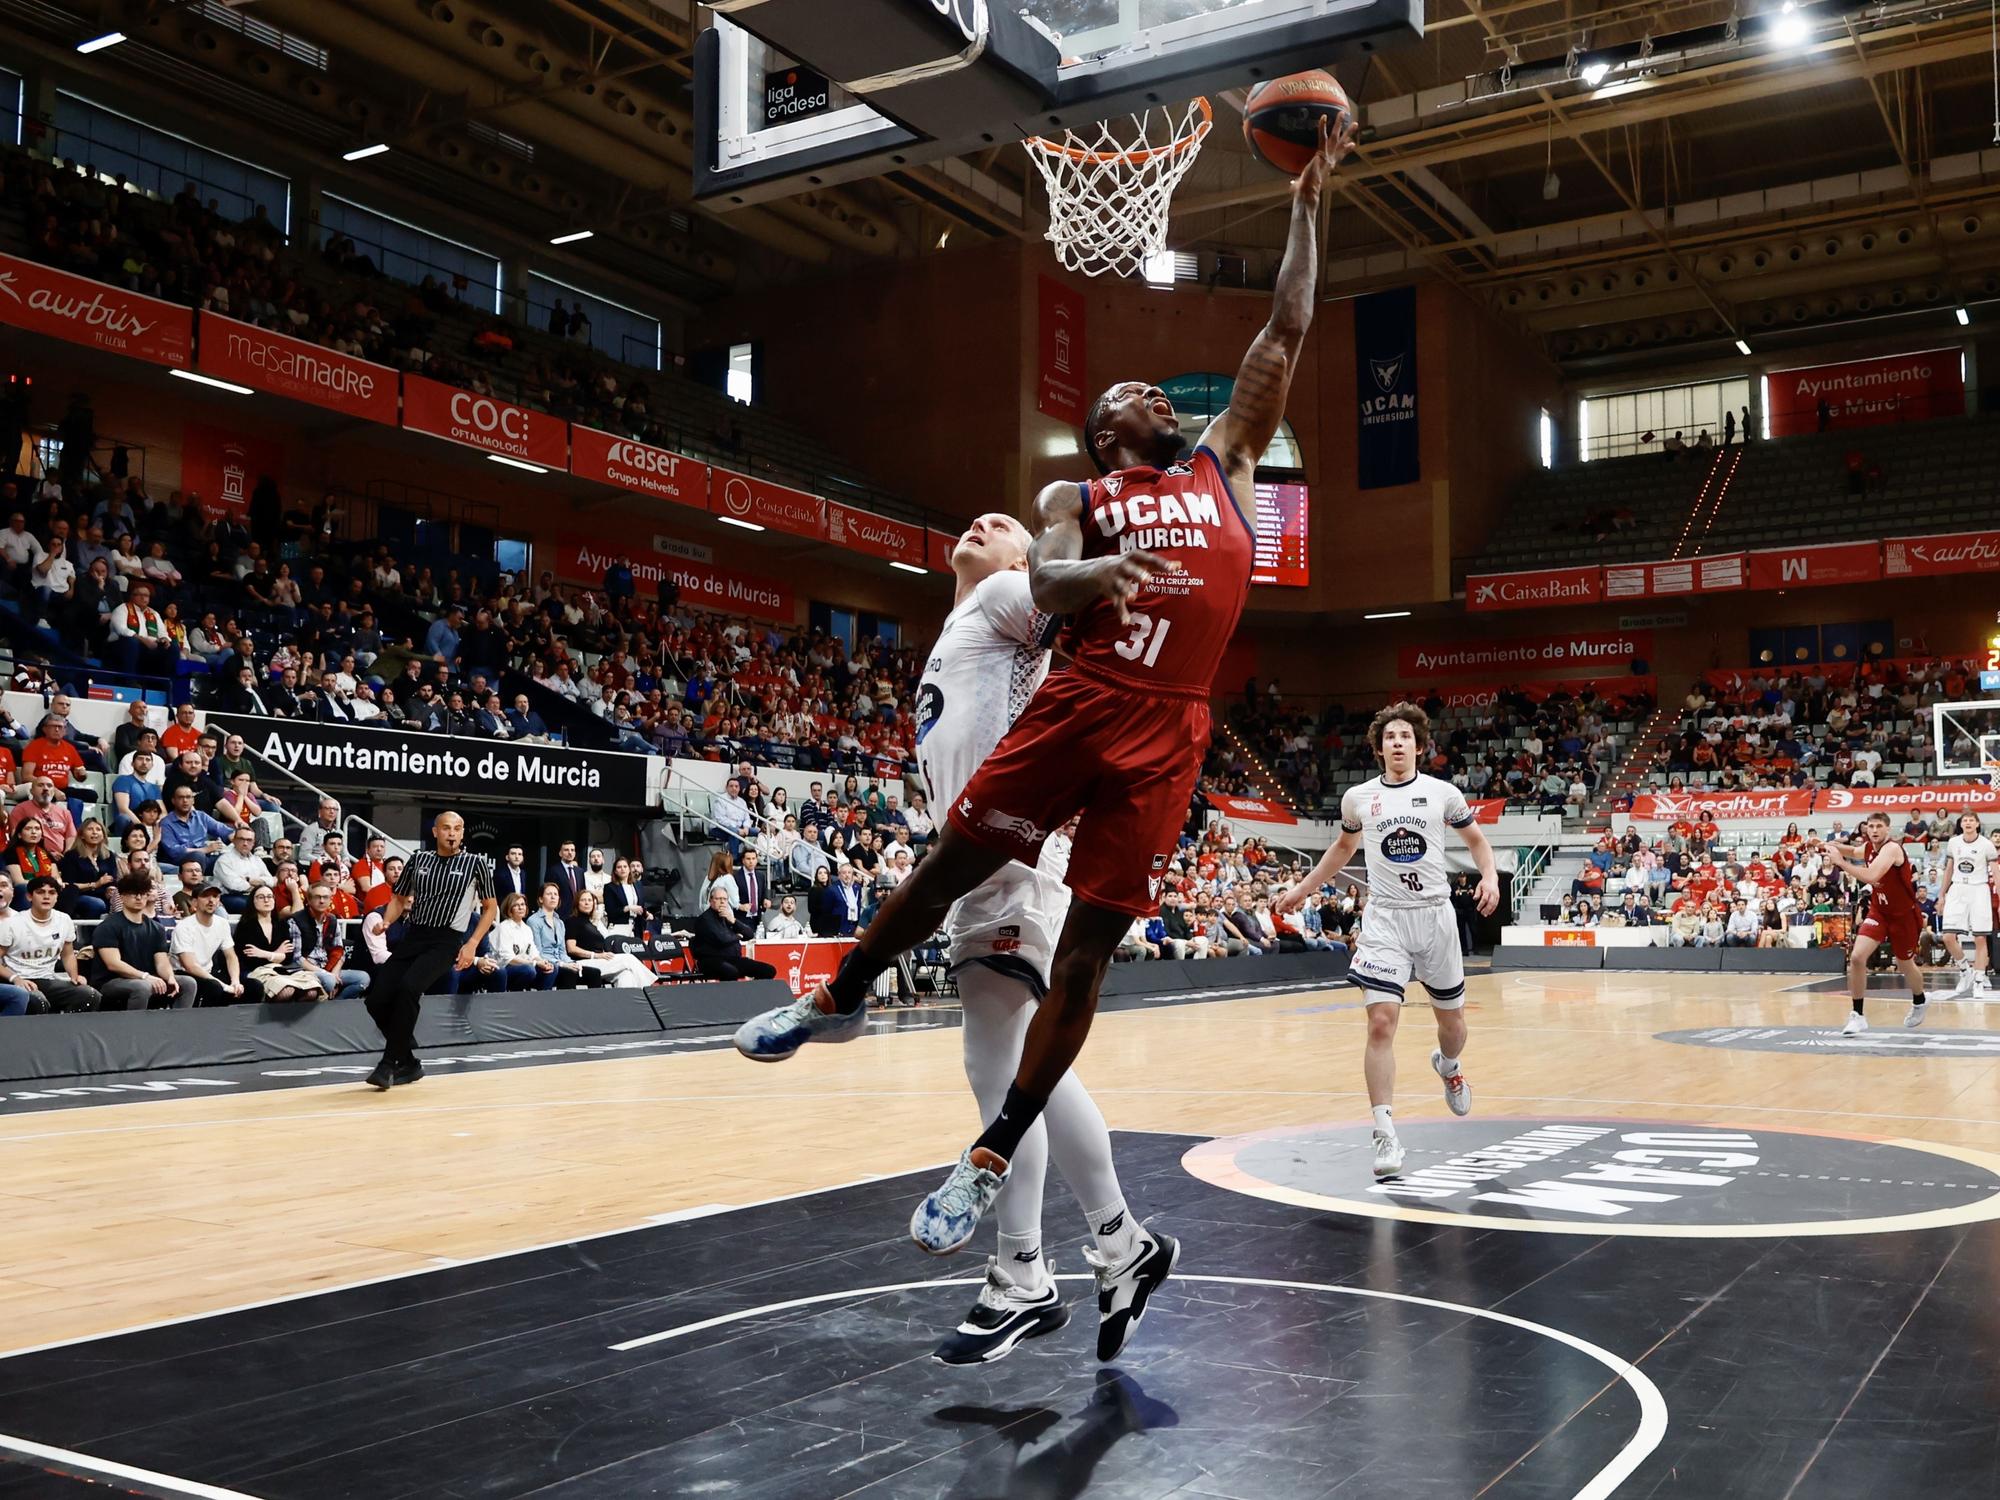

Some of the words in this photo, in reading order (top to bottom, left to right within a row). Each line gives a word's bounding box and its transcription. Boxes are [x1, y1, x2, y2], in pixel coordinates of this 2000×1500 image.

[768, 85, 794, 103] liga
[768, 91, 826, 118] endesa
[1168, 386, 1220, 395] Sprite
[1796, 365, 1933, 397] Ayuntamiento
[1361, 394, 1415, 416] UCAM
[1362, 411, 1415, 426] UNIVERSIDAD
[621, 444, 680, 477] caser
[607, 467, 639, 486] Grupo
[641, 475, 680, 496] Helvetia
[756, 497, 783, 516] Costa
[784, 503, 815, 523] Cálida
[1094, 492, 1221, 537] UCAM
[1119, 528, 1209, 554] MURCIA
[704, 575, 723, 594] de
[728, 579, 781, 607] Murcia
[1144, 584, 1160, 593] AÑO
[1161, 587, 1190, 595] JUBILAR
[1500, 578, 1590, 601] CaixaBank
[1114, 612, 1171, 668] 31
[1416, 648, 1537, 669] Ayuntamiento
[1542, 643, 1564, 658] de
[1570, 638, 1635, 656] Murcia
[261, 731, 470, 777] Ayuntamiento
[477, 750, 510, 780] de
[517, 755, 601, 788] Murcia
[1690, 794, 1788, 810] realturf
[1862, 789, 1996, 805] superDumbo
[1376, 816, 1427, 832] OBRADOIRO
[1387, 837, 1420, 846] Estrella
[1389, 845, 1420, 855] Galicia
[0, 1077, 240, 1101] Mur
[1365, 1125, 1616, 1198] UNIVERSIDAD
[1468, 1132, 1760, 1216] UCAM
